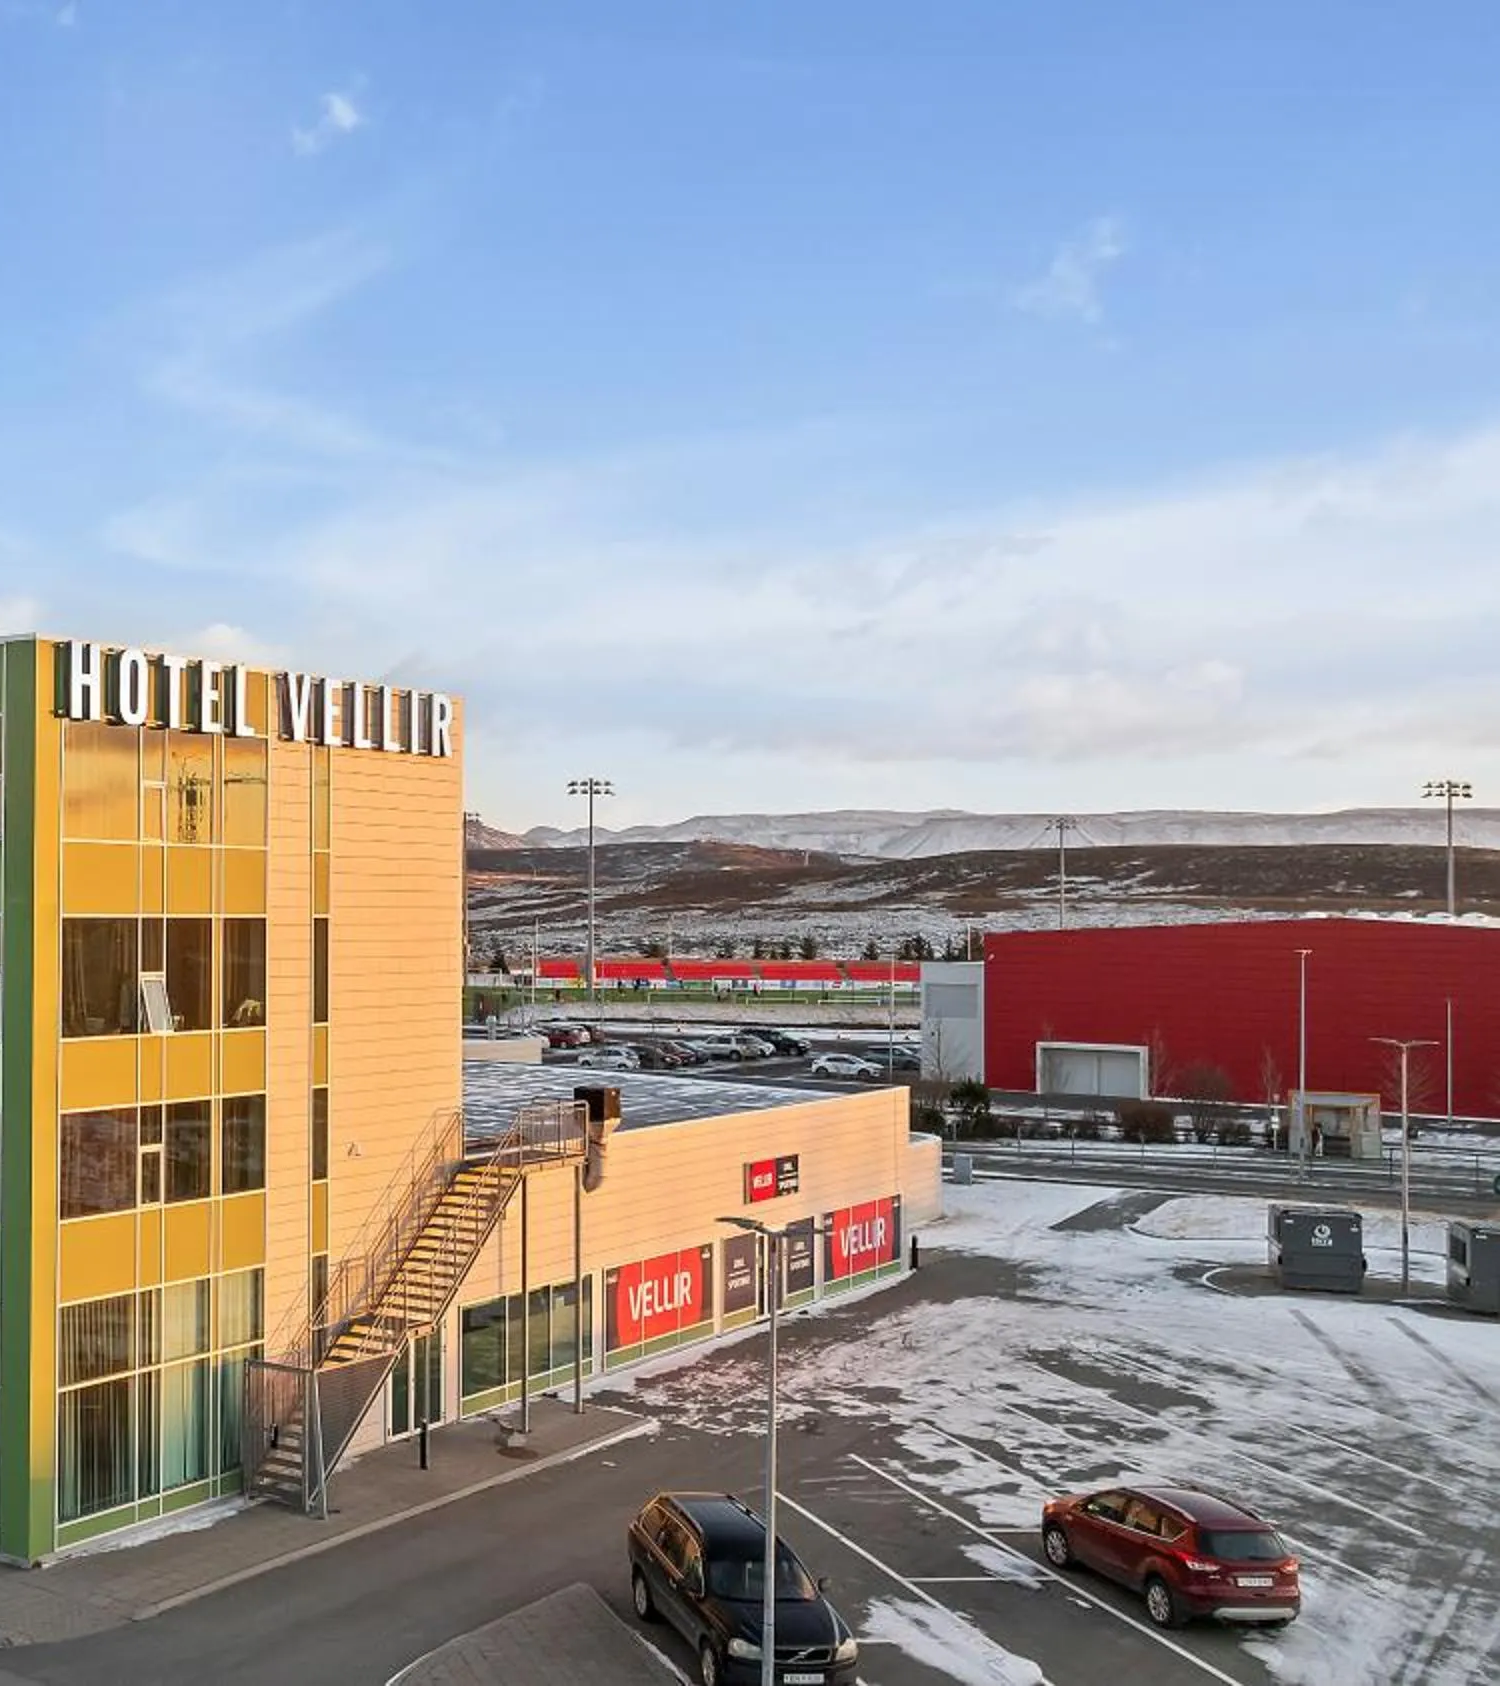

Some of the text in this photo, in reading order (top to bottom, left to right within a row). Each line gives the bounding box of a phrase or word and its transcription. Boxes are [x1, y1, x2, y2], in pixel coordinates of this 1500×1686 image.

[57, 639, 452, 757] HOTEL VELLIR
[840, 1216, 886, 1258] VELLIR
[628, 1271, 693, 1321] VELLIR
